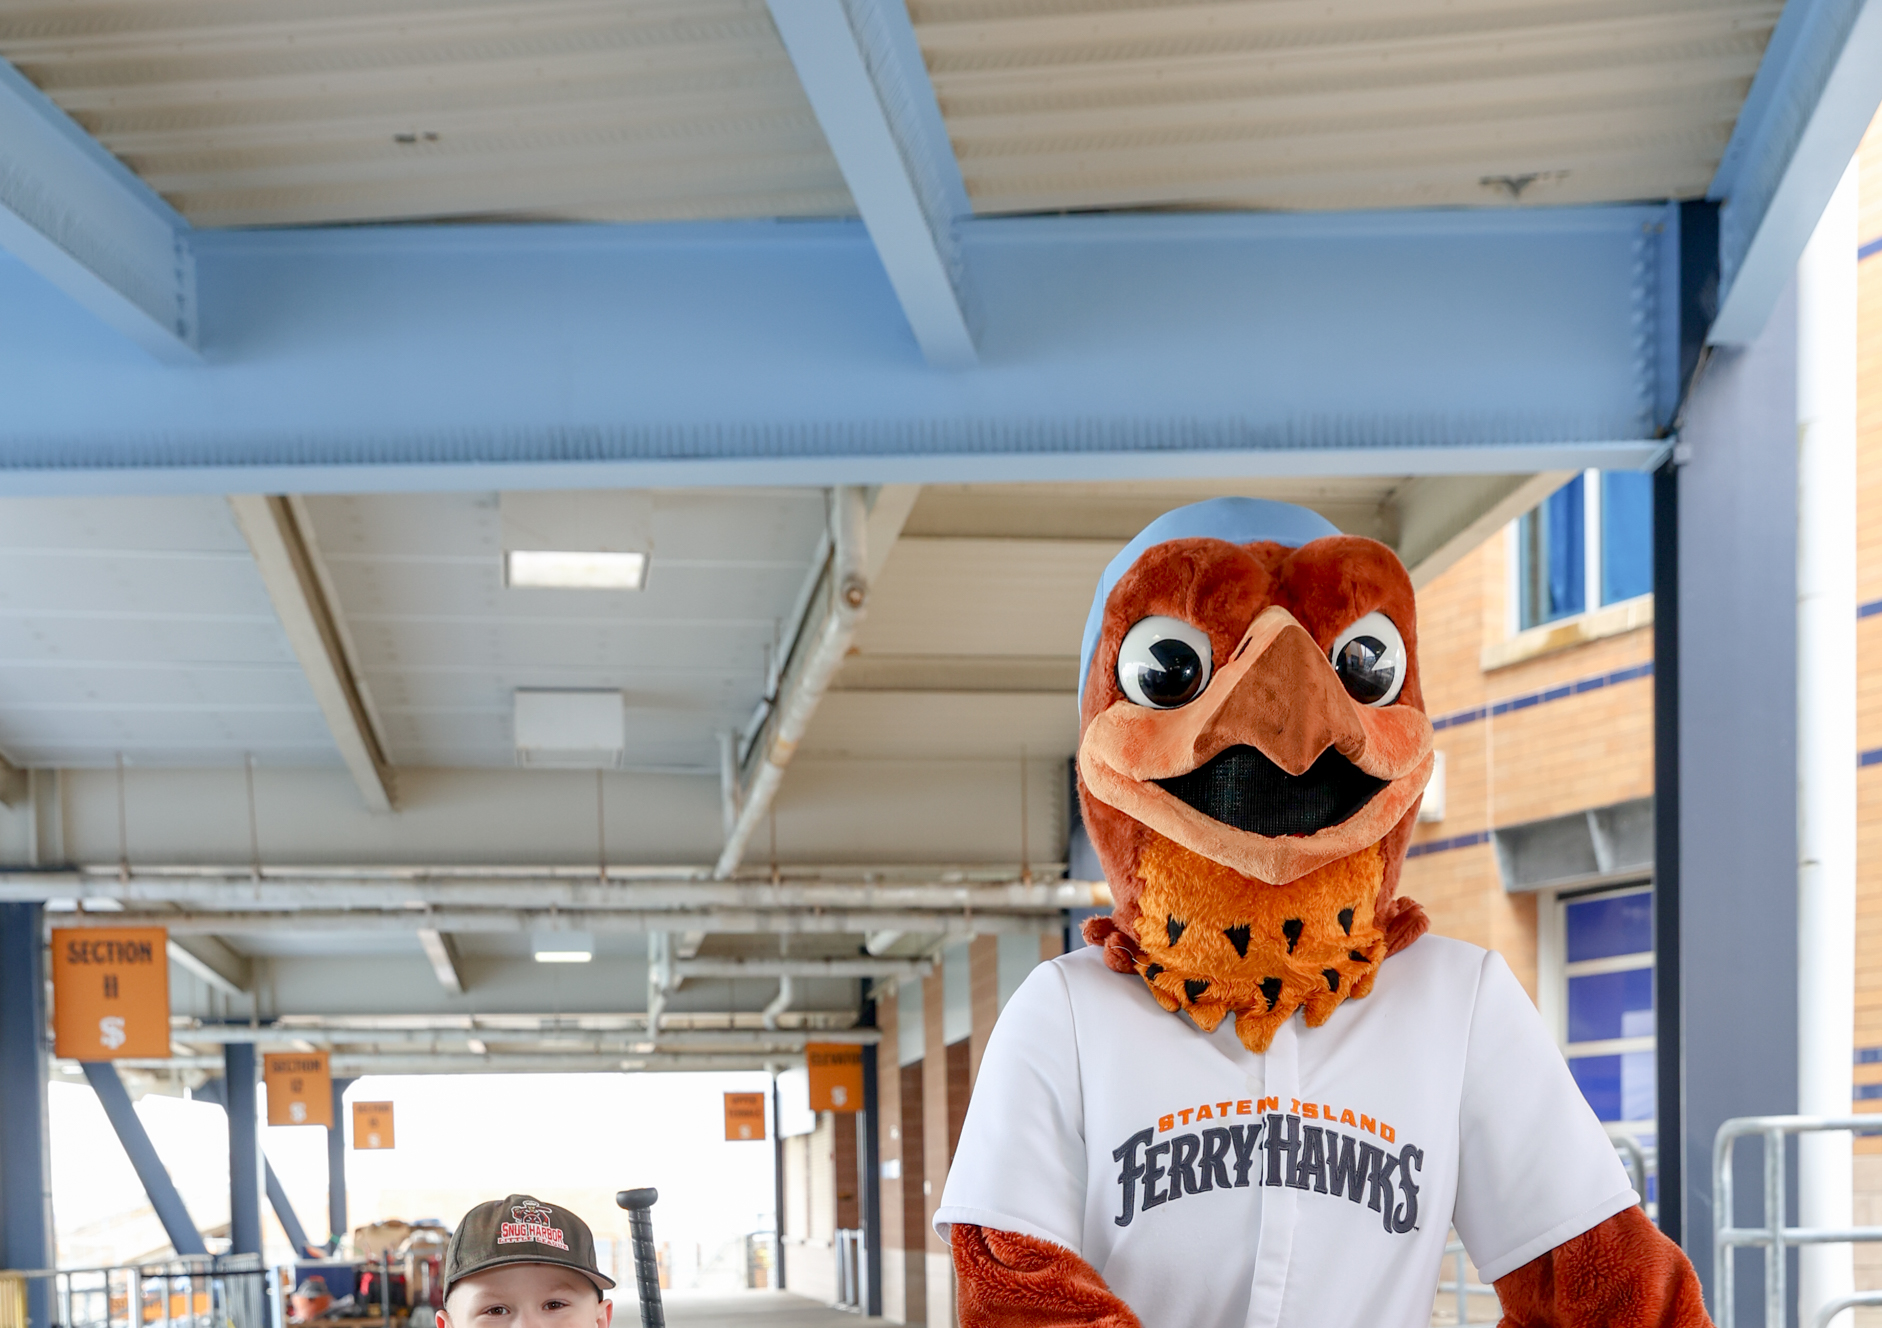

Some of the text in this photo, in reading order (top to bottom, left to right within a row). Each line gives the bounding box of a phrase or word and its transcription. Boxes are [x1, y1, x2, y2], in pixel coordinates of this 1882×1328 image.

[67, 940, 152, 964] SECTION
[1158, 1096, 1396, 1144] STATEN ISLAND
[498, 1236, 569, 1251] LITTLE LEAGUE
[501, 1222, 564, 1245] SNUG HARBOR
